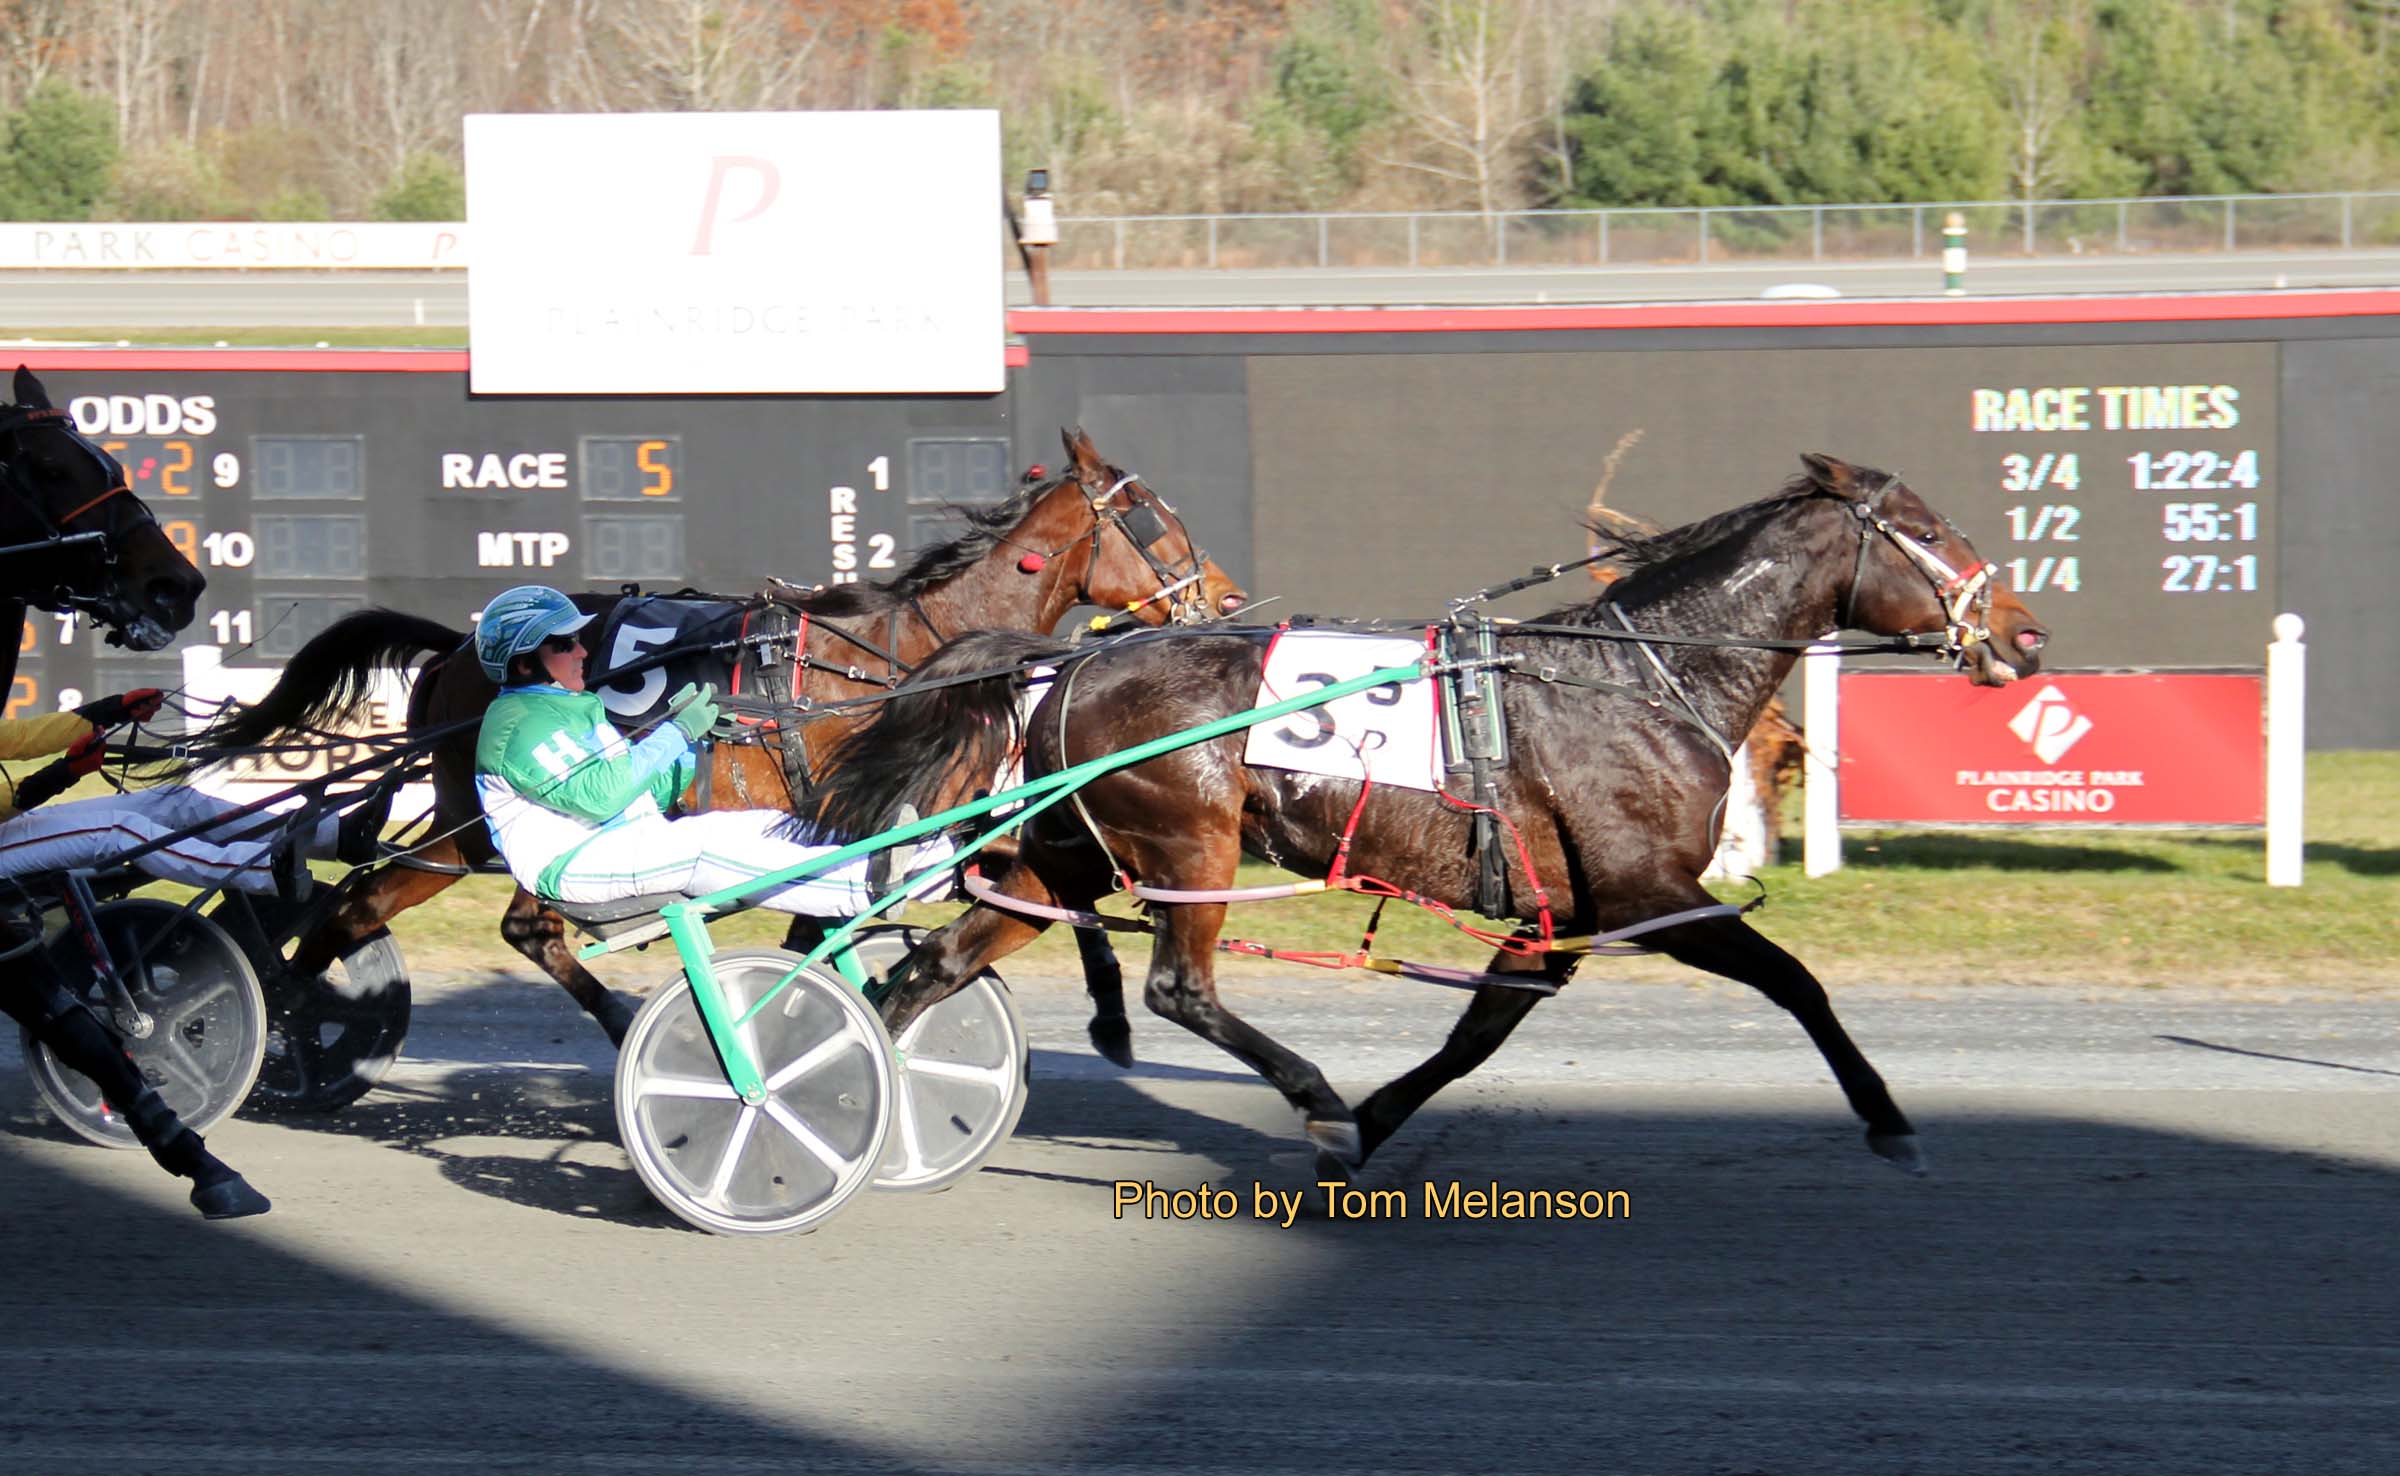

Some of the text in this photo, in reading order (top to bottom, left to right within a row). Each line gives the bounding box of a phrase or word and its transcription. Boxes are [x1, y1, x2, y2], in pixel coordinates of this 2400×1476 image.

[688, 154, 783, 257] P
[34, 229, 358, 262] PARK CASINO
[546, 302, 943, 337] PLAINRIDGE PARK
[69, 394, 217, 436] ODDS
[1973, 385, 2239, 432] RACE TIMES
[213, 452, 240, 488] 9
[442, 453, 568, 489] RACE
[636, 440, 673, 497] 5
[867, 455, 890, 491] 1
[2002, 450, 2259, 491] 3/4 1:22:4
[2005, 503, 2257, 542] 1/2 55:1
[202, 531, 255, 567] 10
[478, 532, 570, 568] MTP
[868, 533, 896, 569] 2
[2005, 554, 2257, 593] 1/4 27:1
[55, 611, 81, 645] 7
[210, 610, 252, 645] 11
[598, 624, 677, 717] 5
[1273, 672, 1337, 750] 3
[531, 729, 590, 781] H
[1956, 770, 2145, 787] PLAINRIDGE PARK
[1986, 788, 2115, 814] CASINO
